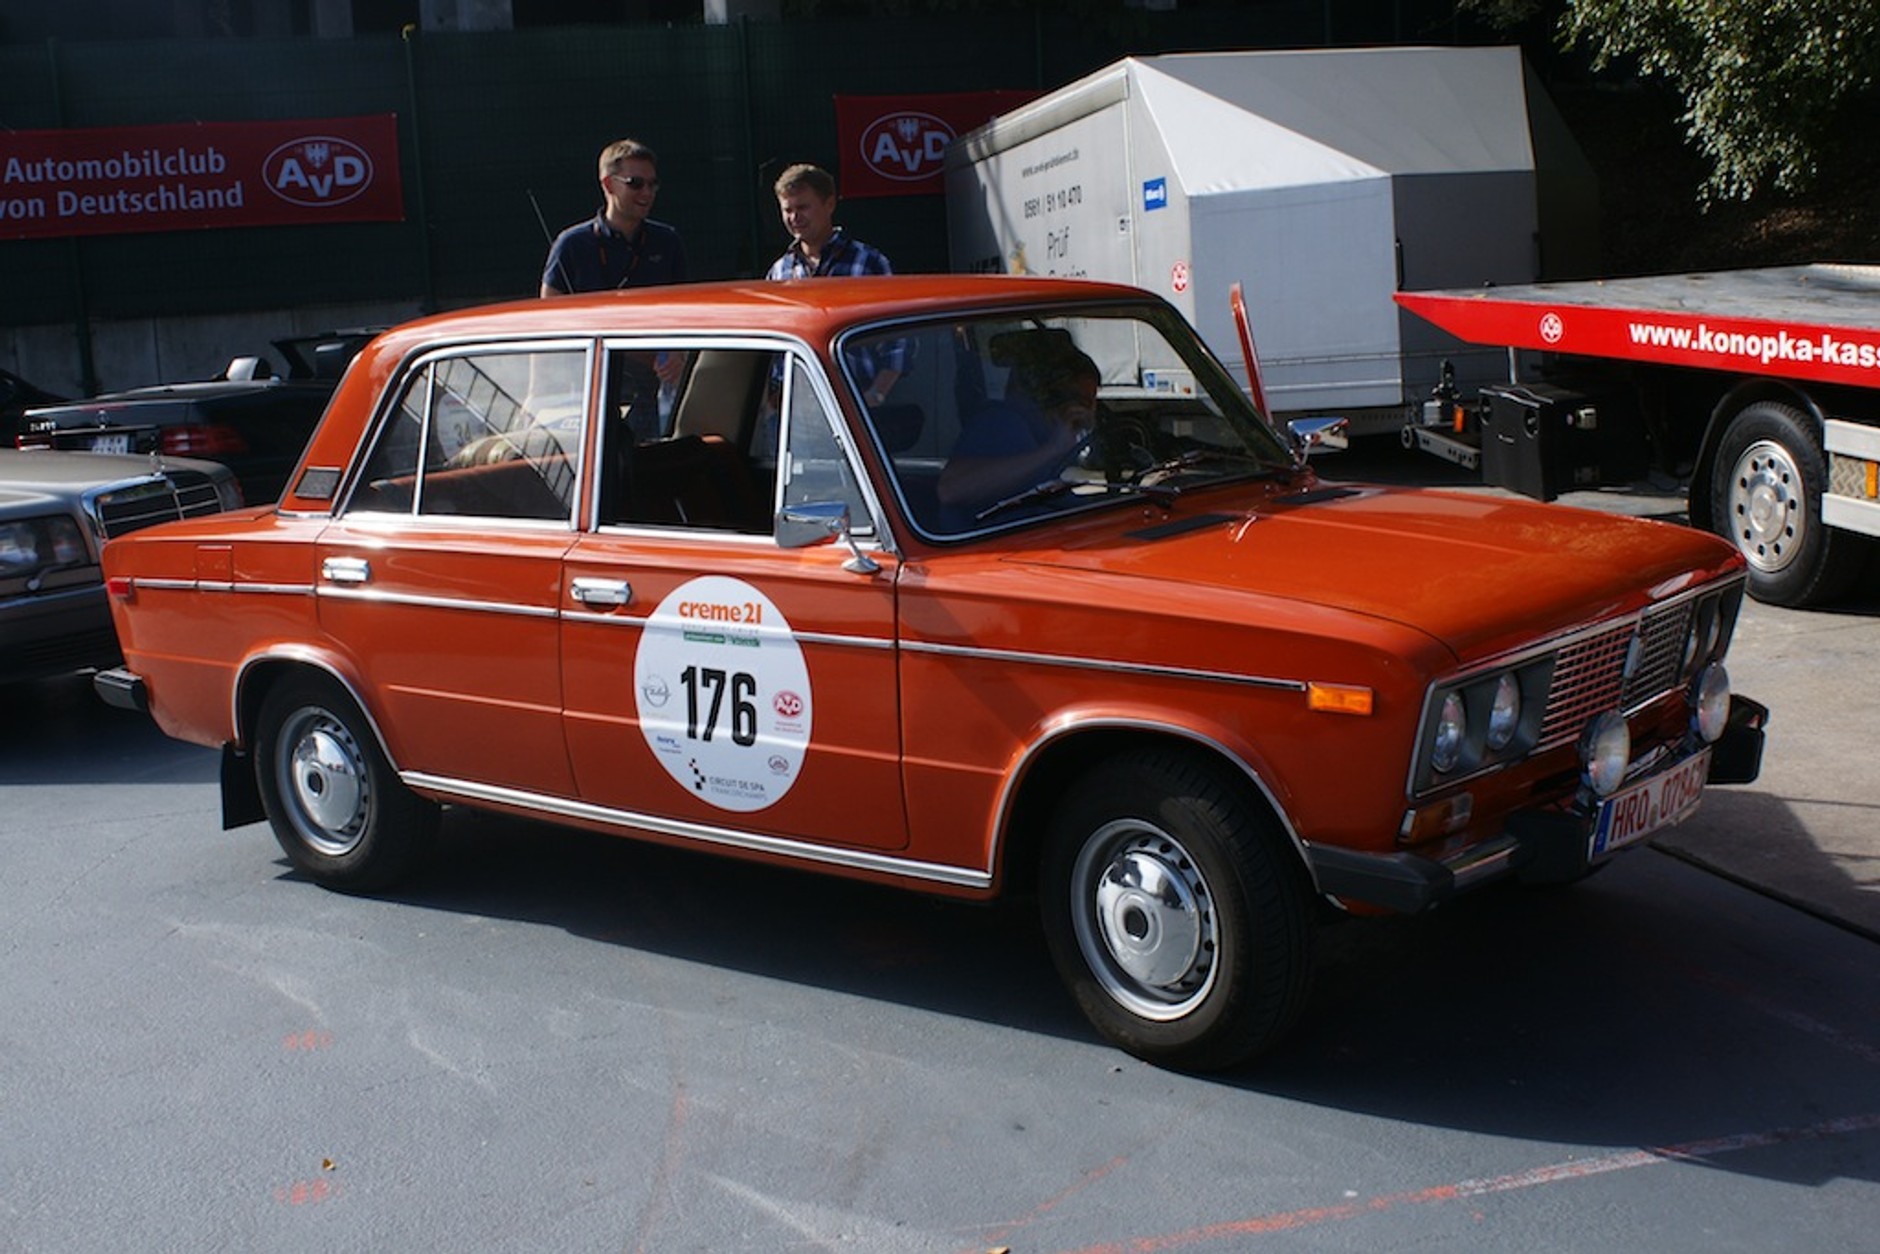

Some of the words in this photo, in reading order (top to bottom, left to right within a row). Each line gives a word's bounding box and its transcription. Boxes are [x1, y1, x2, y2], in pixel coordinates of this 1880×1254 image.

[4, 147, 226, 184] Automobilclub
[58, 181, 244, 217] Deutschland
[1047, 226, 1070, 260] Prüf
[1630, 323, 1880, 368] www.konopka-kas
[680, 665, 757, 748] 176
[750, 781, 765, 792] SPA
[1610, 788, 1649, 842] HRO
